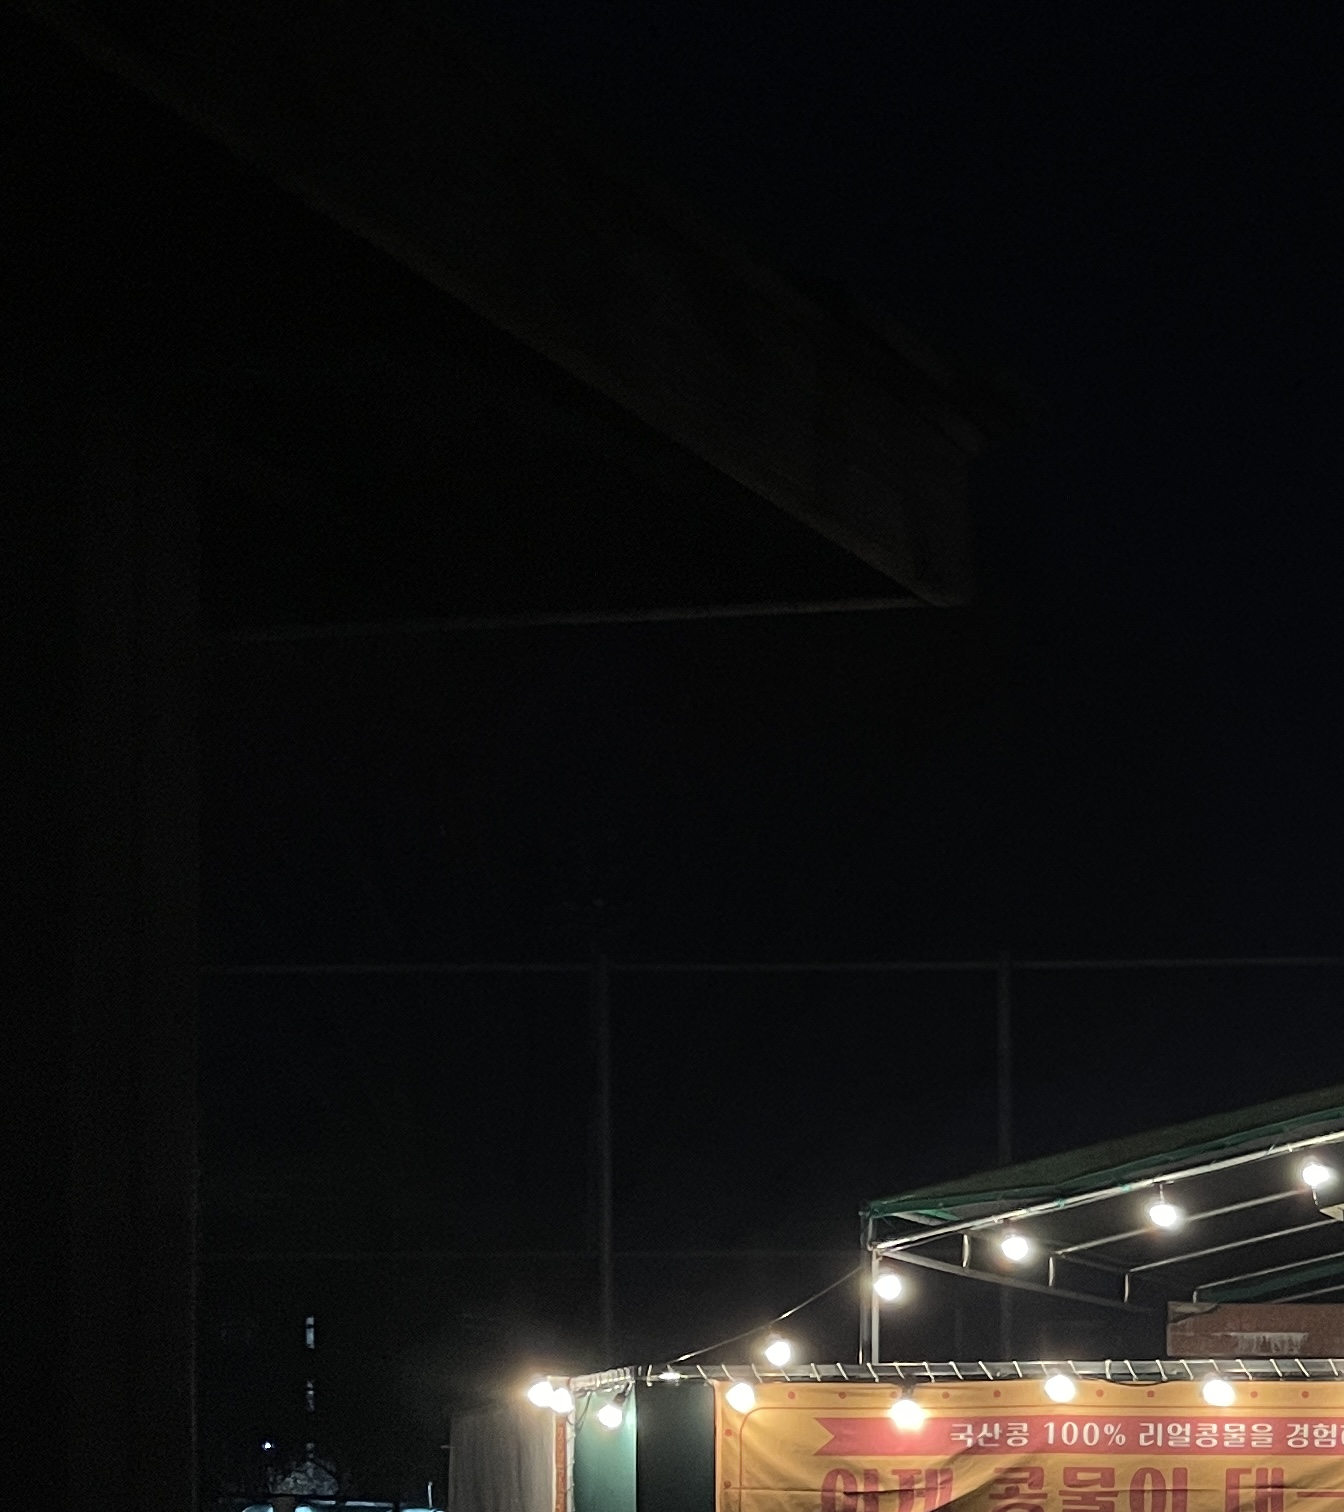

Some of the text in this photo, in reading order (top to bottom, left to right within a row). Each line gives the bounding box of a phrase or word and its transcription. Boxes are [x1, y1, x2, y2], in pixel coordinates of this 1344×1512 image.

[950, 1421, 1030, 1448] 국산콩
[1043, 1420, 1126, 1447] 100%
[1138, 1421, 1275, 1448] 리얼콩물을
